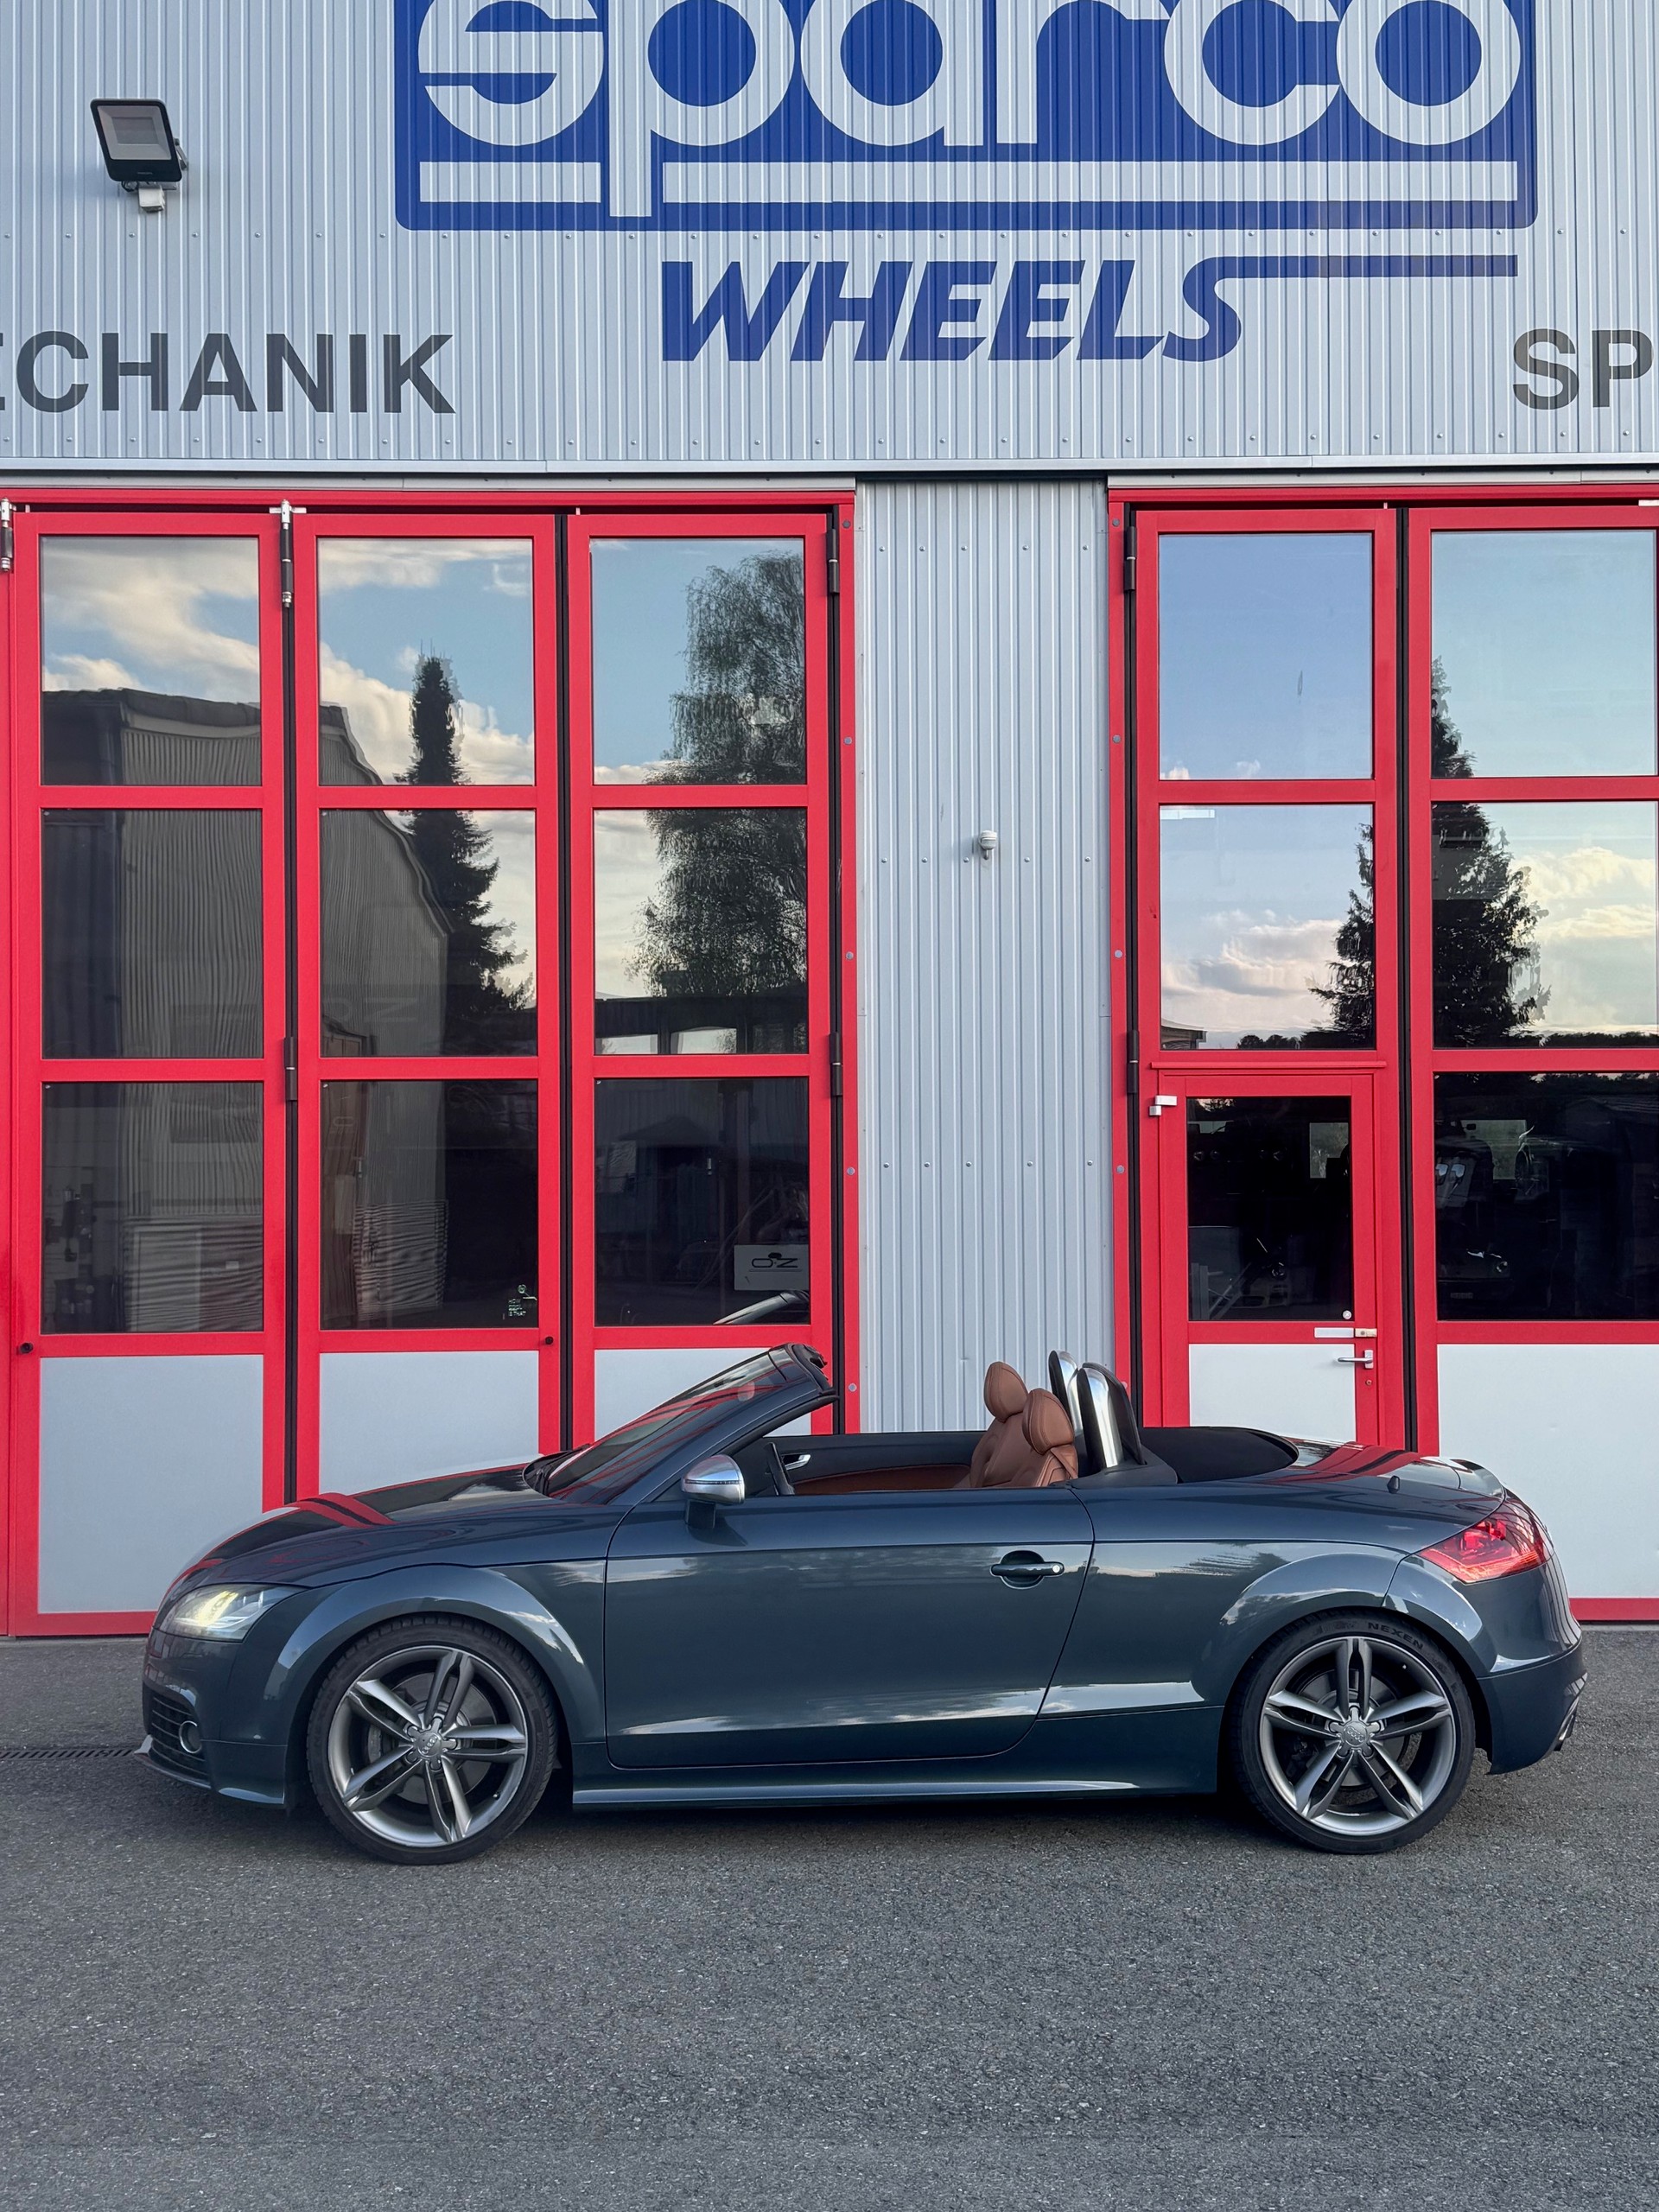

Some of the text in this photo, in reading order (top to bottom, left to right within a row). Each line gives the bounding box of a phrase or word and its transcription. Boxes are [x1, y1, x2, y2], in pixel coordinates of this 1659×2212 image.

[418, 0, 1520, 216] sparco
[662, 255, 1518, 363] WHEELS
[0, 330, 455, 413] CHANIK
[1513, 328, 1655, 410] SP
[1368, 1622, 1423, 1649] NEXEN
